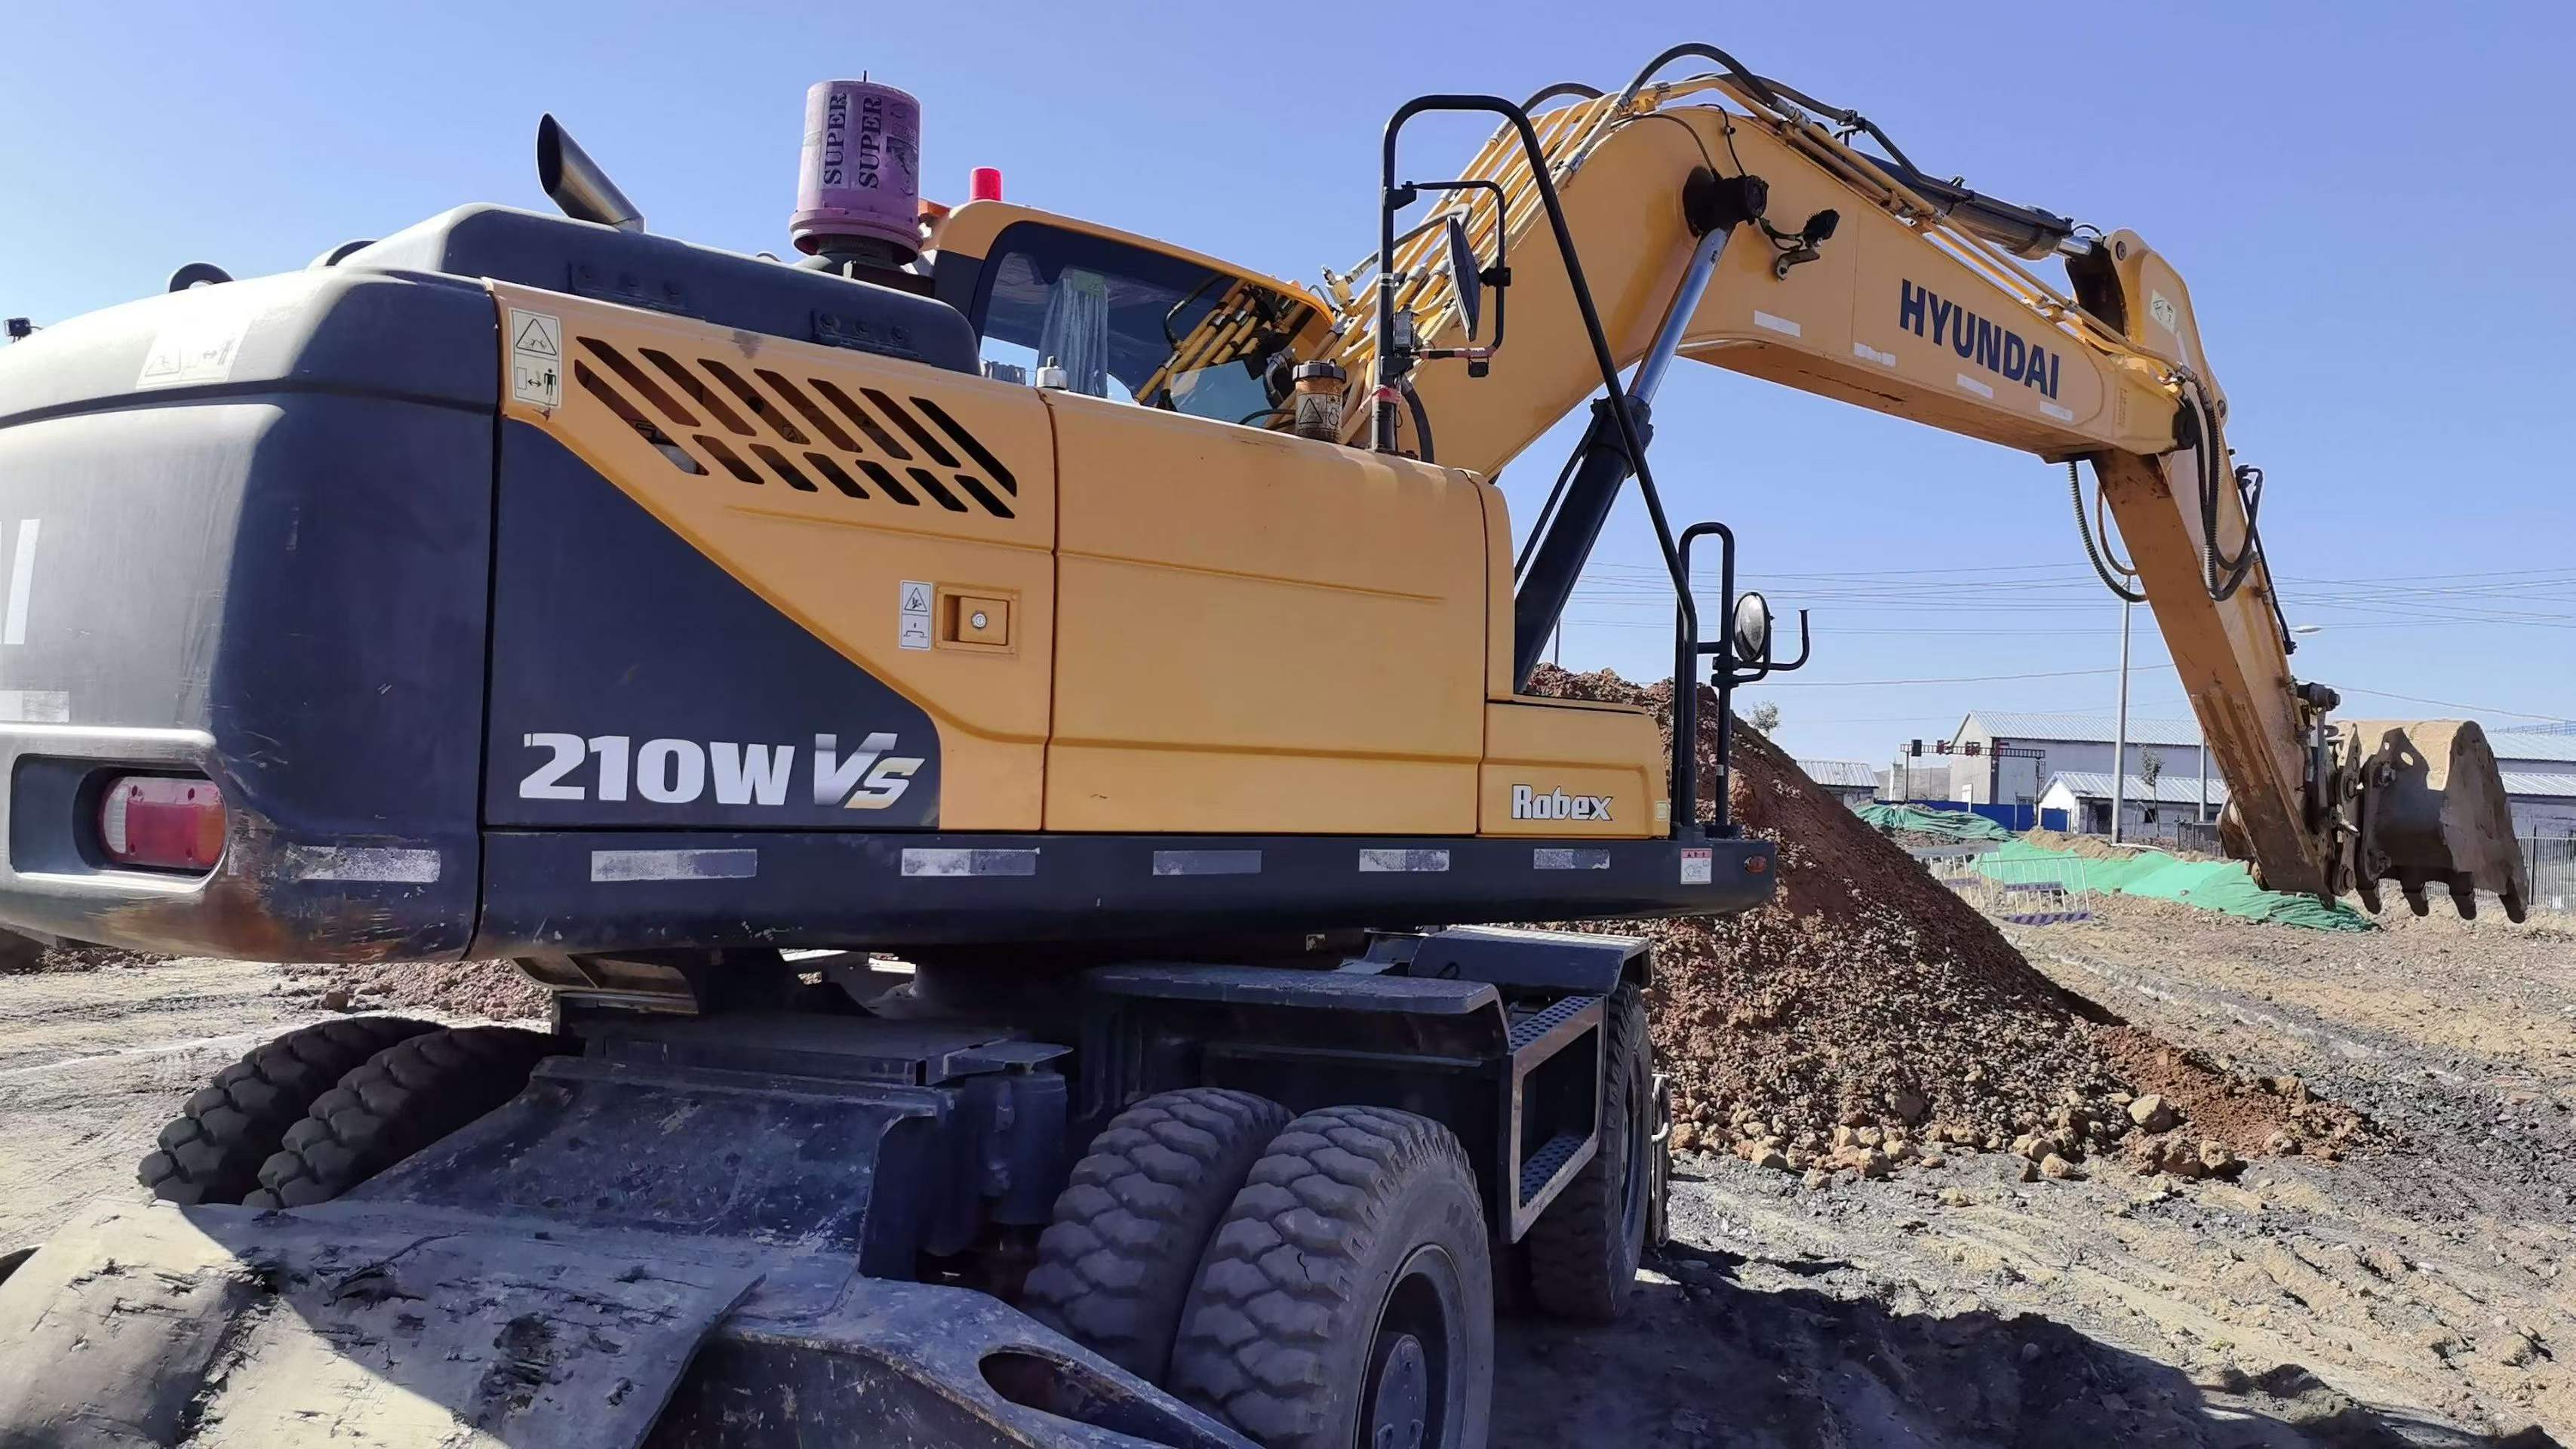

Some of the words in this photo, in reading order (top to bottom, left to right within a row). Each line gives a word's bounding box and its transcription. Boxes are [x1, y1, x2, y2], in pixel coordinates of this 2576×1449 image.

[823, 92, 847, 184] SUPER
[859, 97, 882, 189] SUPER
[1900, 278, 2059, 400] HYUNDAI
[519, 733, 795, 805] 210W
[1511, 783, 1614, 821] Robex
